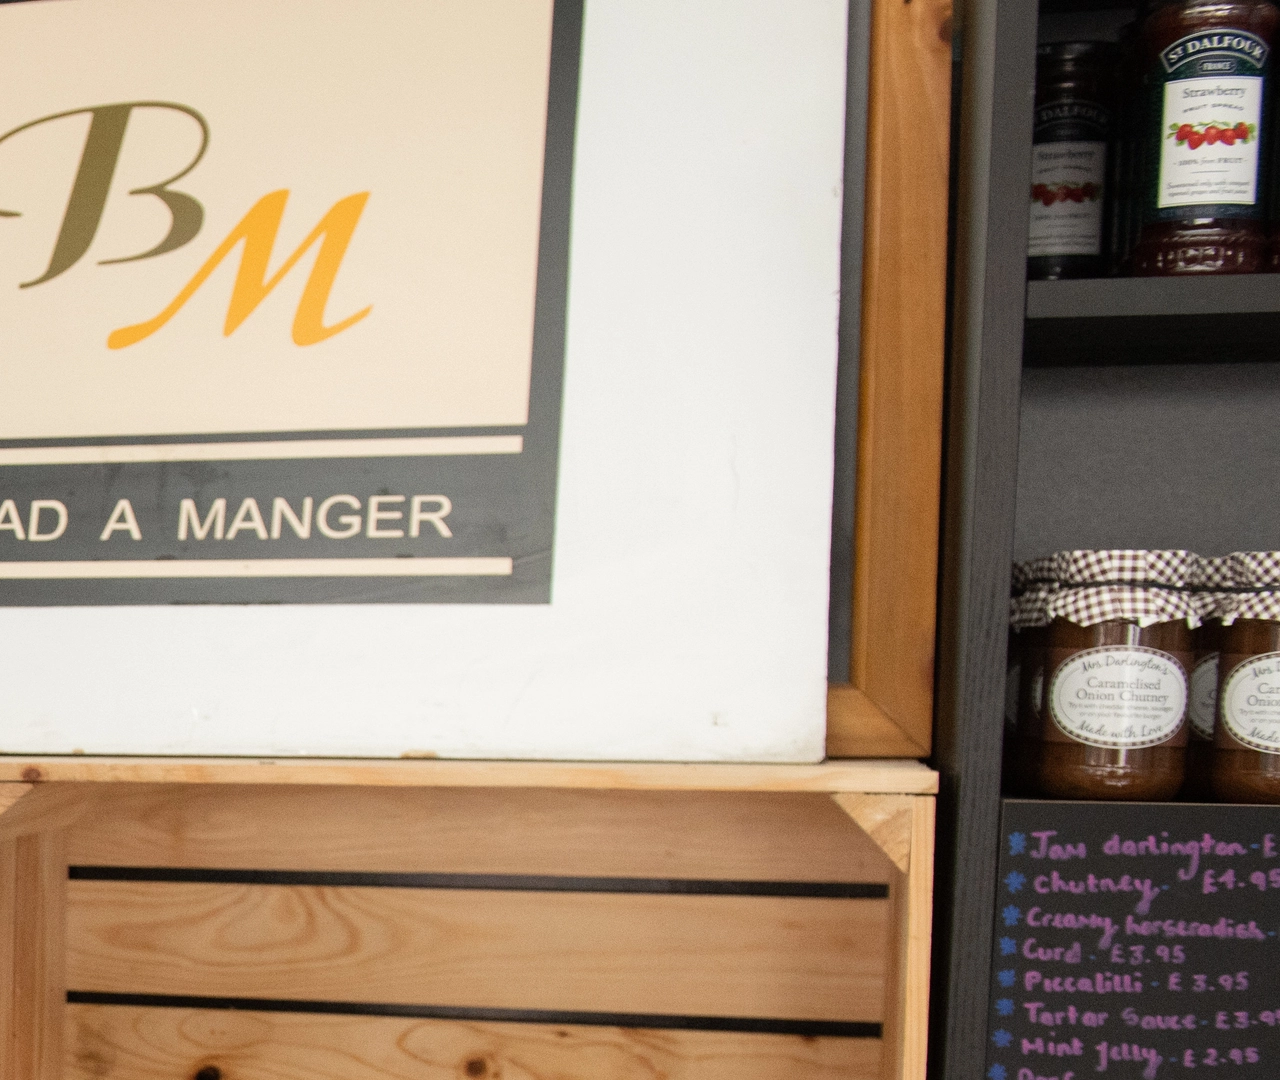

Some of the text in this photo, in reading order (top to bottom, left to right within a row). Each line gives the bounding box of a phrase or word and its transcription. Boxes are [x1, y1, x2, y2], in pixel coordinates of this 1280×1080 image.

[1182, 85, 1247, 99] Strawberry
[99, 498, 142, 541] A
[177, 494, 453, 541] MANGER
[1076, 688, 1116, 701] Onion
[1087, 676, 1161, 690] Caramelised
[1033, 869, 1160, 915] Chutney
[1025, 906, 1120, 950] Creamy
[1022, 937, 1083, 965] Curd
[1121, 1007, 1197, 1031] Sauce
[1020, 1031, 1085, 1057] Mint
